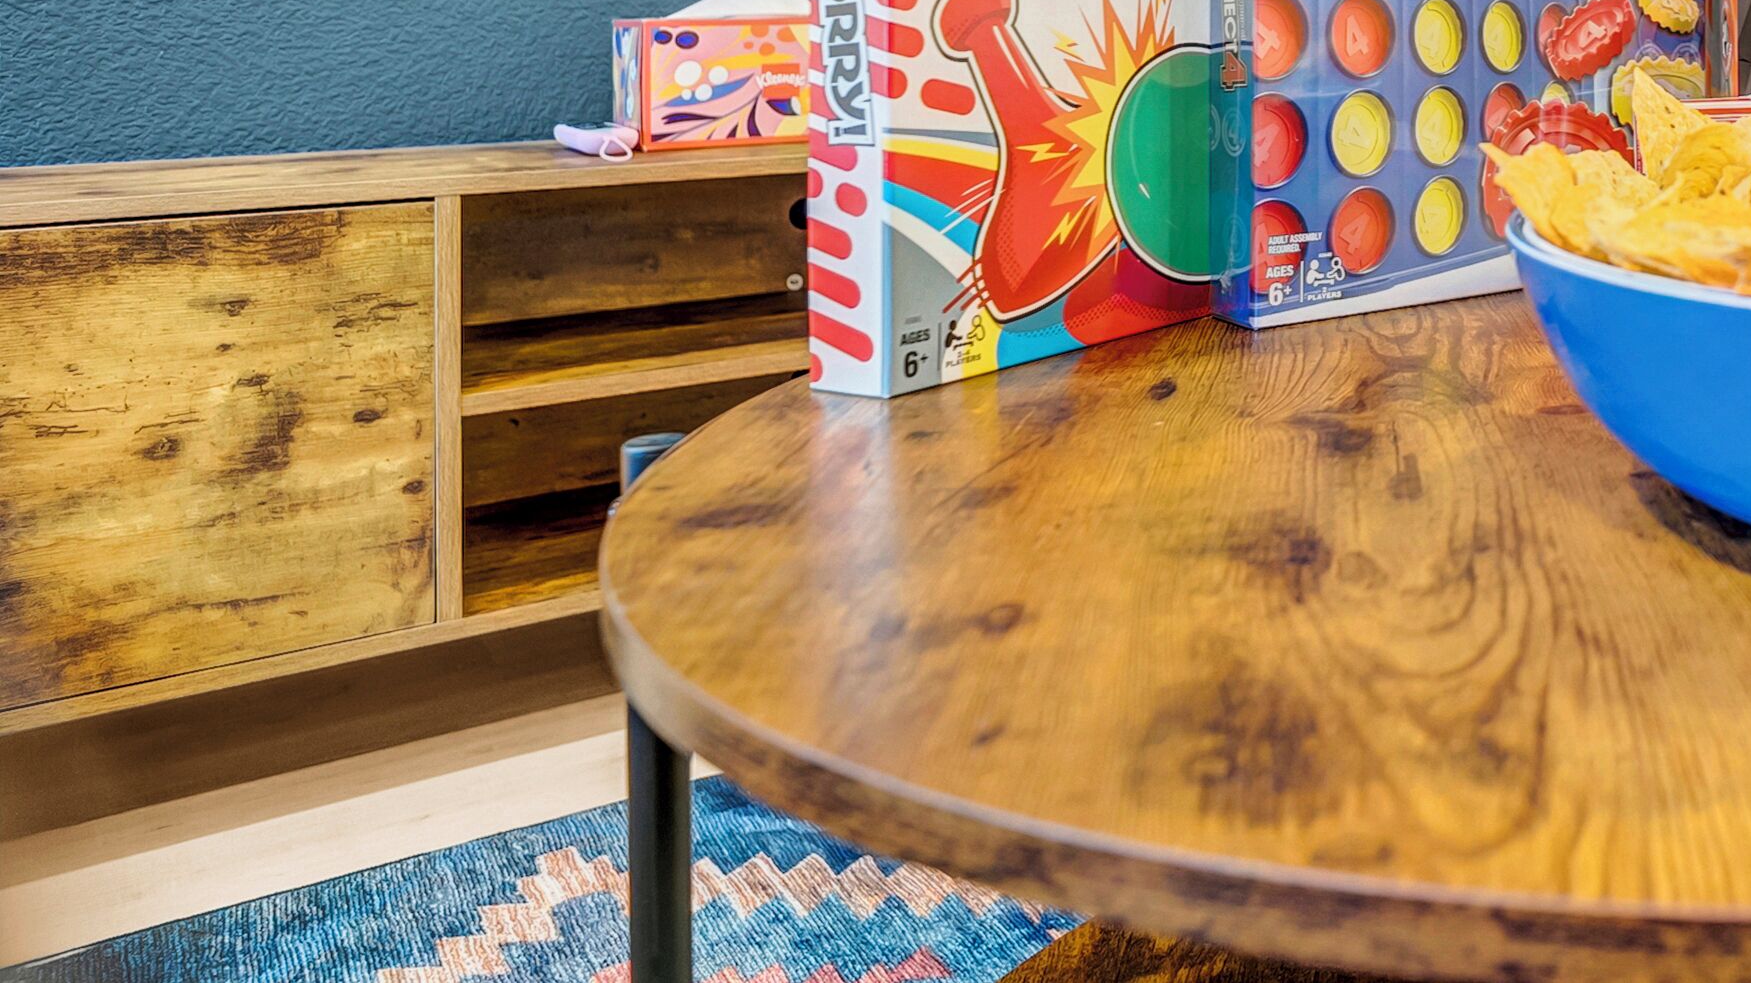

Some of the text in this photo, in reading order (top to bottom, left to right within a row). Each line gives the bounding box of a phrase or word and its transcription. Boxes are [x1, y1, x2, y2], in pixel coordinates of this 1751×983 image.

[1221, 52, 1247, 89] 4
[1268, 232, 1322, 245] ADULT ASSEMBLY
[1266, 265, 1294, 278] AGES
[1269, 282, 1292, 306] 6+
[1308, 291, 1342, 301] PLAYERS
[900, 328, 930, 346] AGES
[904, 351, 928, 378] 6+
